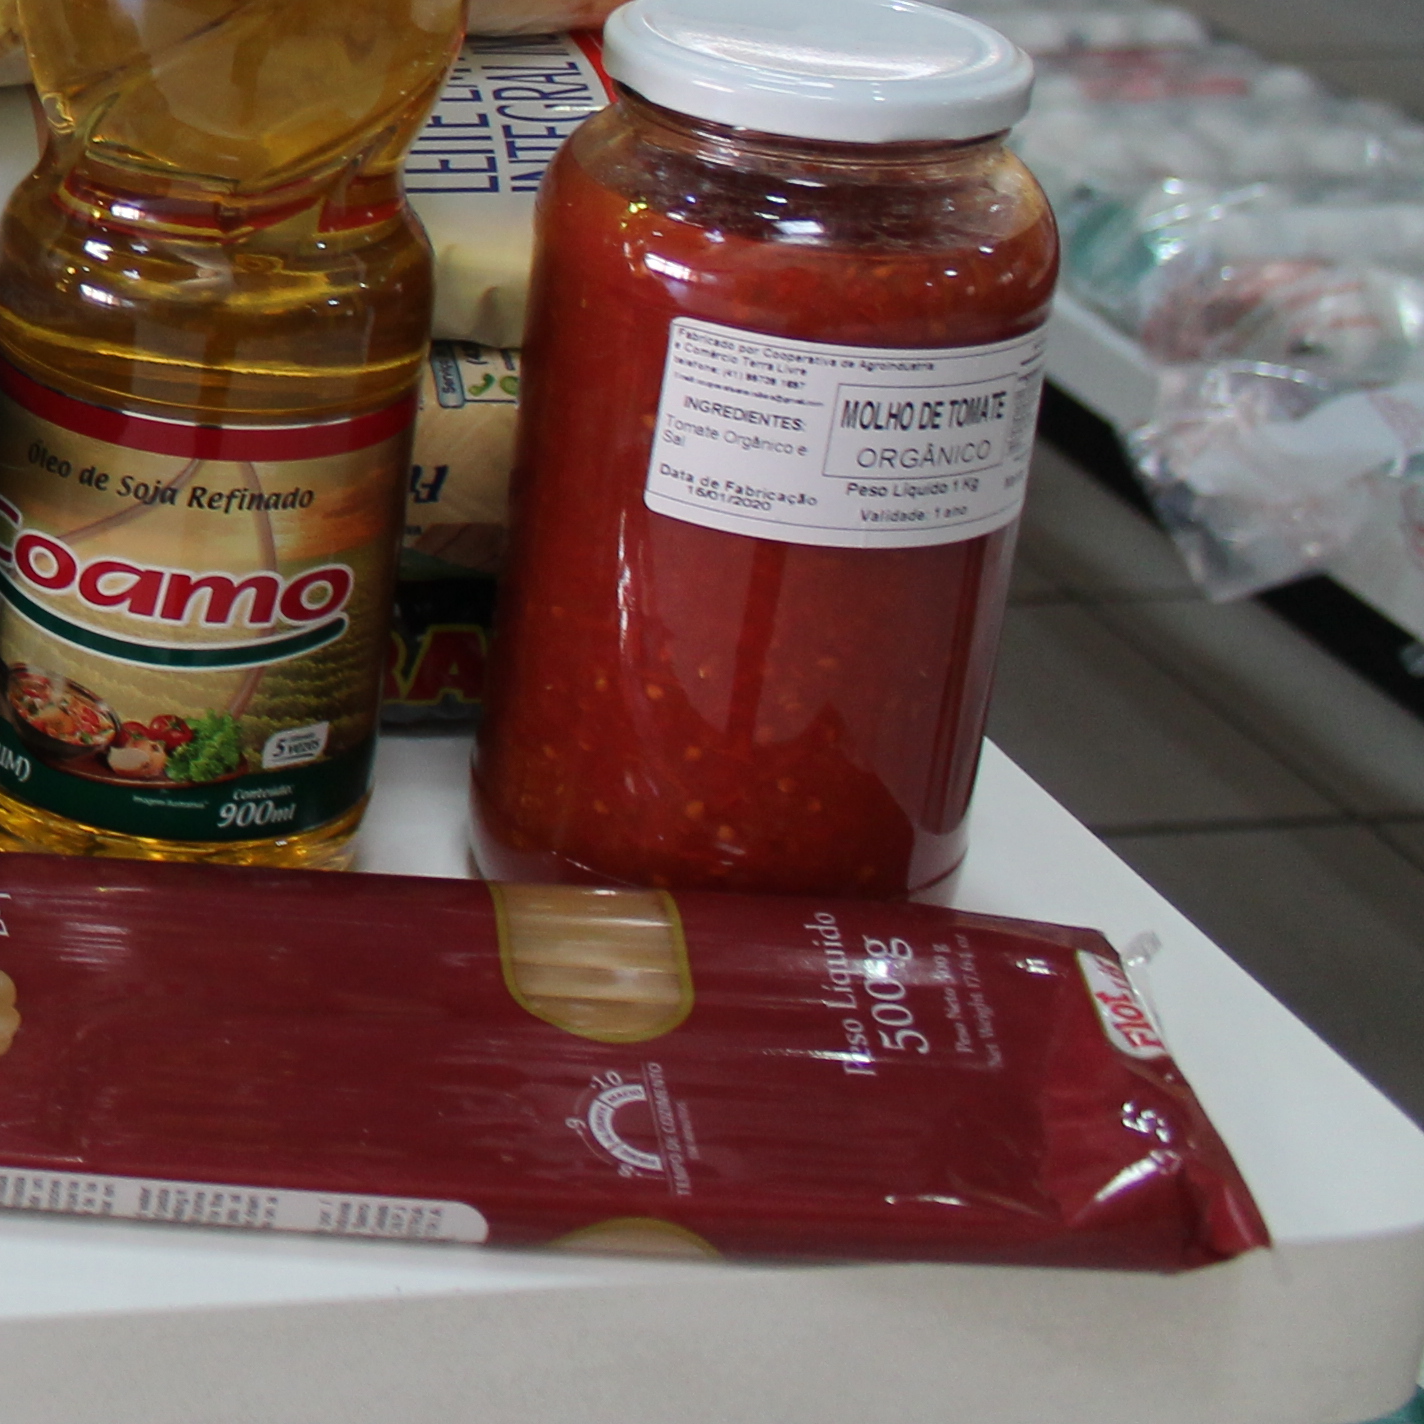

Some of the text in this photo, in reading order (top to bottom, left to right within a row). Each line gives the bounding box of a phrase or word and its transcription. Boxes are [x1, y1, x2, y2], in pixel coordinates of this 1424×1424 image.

[679, 327, 735, 350] Fabricado
[684, 395, 806, 433] INGREDIENTES:
[840, 399, 914, 431] MOLHO
[919, 401, 945, 430] DE
[947, 390, 1008, 428] TOMATE
[663, 428, 686, 447] Sal
[666, 413, 808, 456] Tomate Orgânico e
[856, 438, 992, 470] ORGÂNICO
[28, 441, 316, 515] Óleo de Soja Refinado
[659, 462, 818, 507] Data de Fabricação
[845, 481, 888, 497] Peso
[893, 481, 949, 500] Líquido
[217, 800, 297, 828] 900ml
[803, 911, 858, 1010] Líquido
